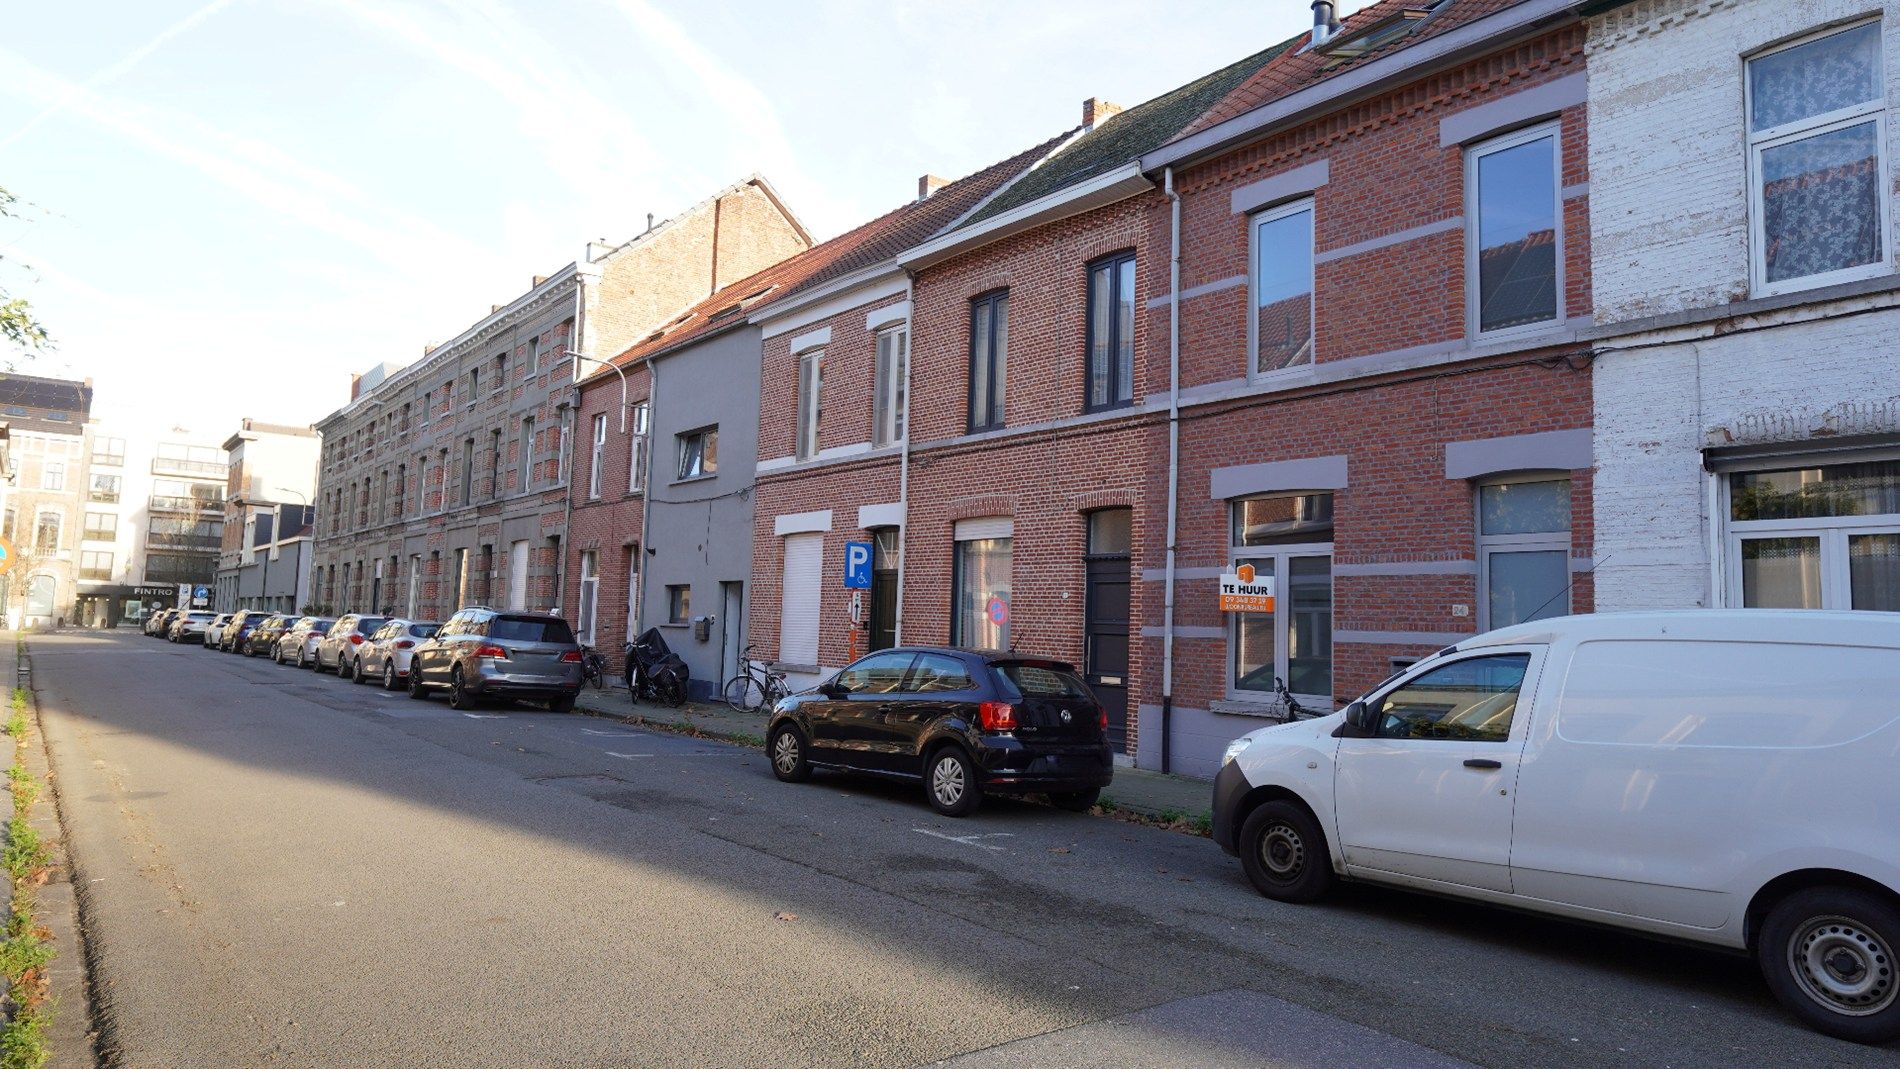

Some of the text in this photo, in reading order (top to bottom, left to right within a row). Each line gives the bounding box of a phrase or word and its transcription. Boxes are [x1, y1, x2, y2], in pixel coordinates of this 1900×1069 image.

[848, 545, 868, 578] P
[134, 587, 173, 596] FINTRO
[1223, 584, 1268, 596] TE HUUR
